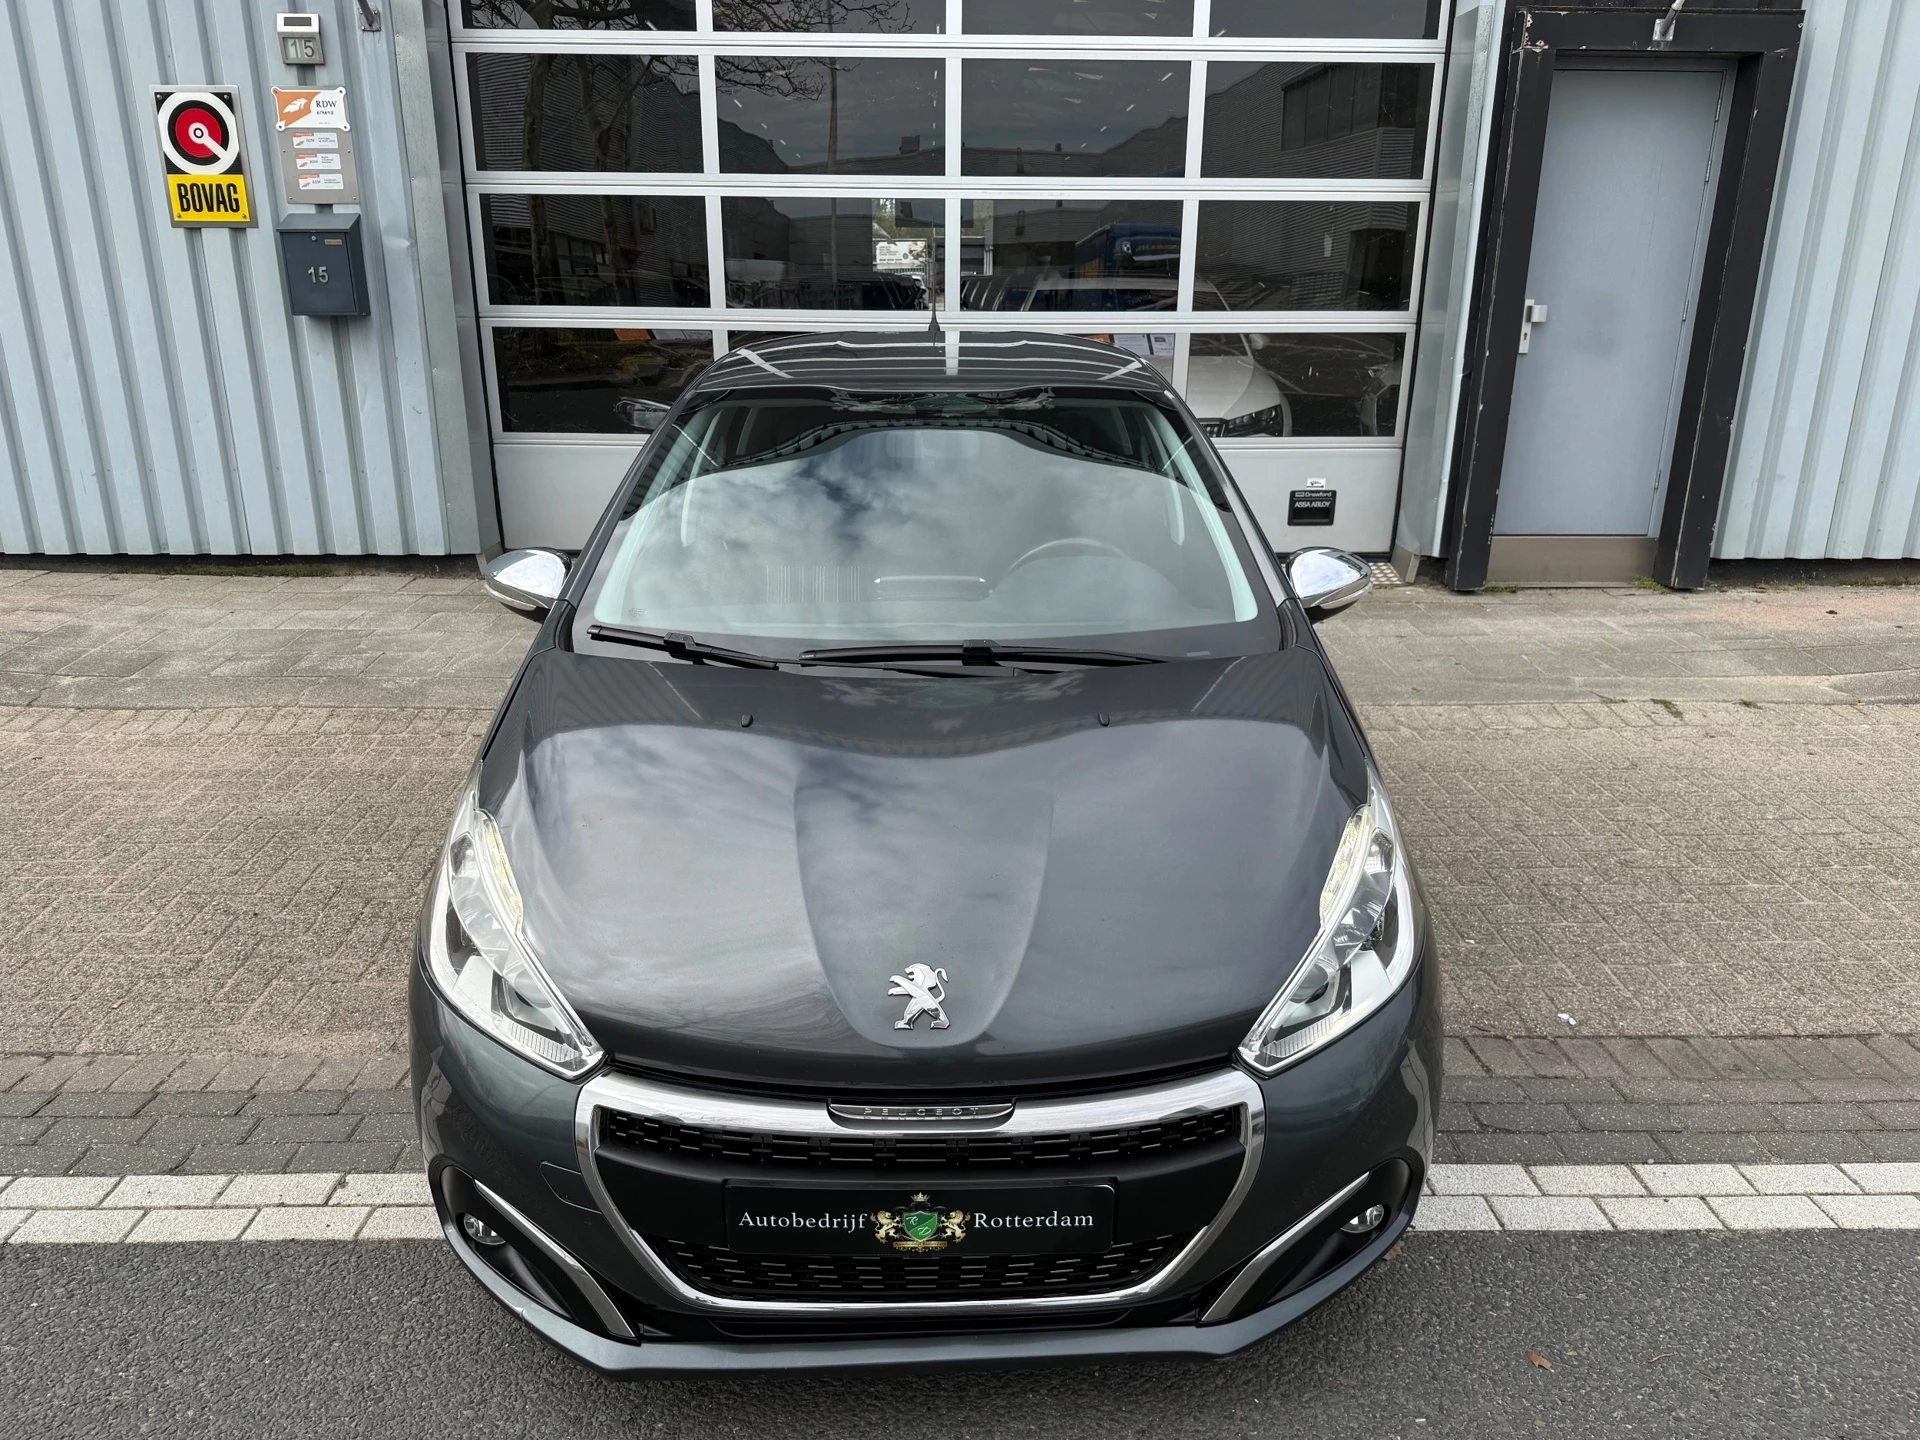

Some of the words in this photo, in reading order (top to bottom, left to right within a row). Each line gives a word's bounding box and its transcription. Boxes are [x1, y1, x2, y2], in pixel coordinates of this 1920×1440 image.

[290, 39, 315, 58] 15
[315, 100, 337, 109] RDW
[177, 183, 240, 213] BOVAG
[307, 266, 329, 284] 15
[863, 1107, 979, 1116] PEUGEOT
[739, 1211, 868, 1233] Autobedrijf
[973, 1211, 1094, 1229] Rotterdam
